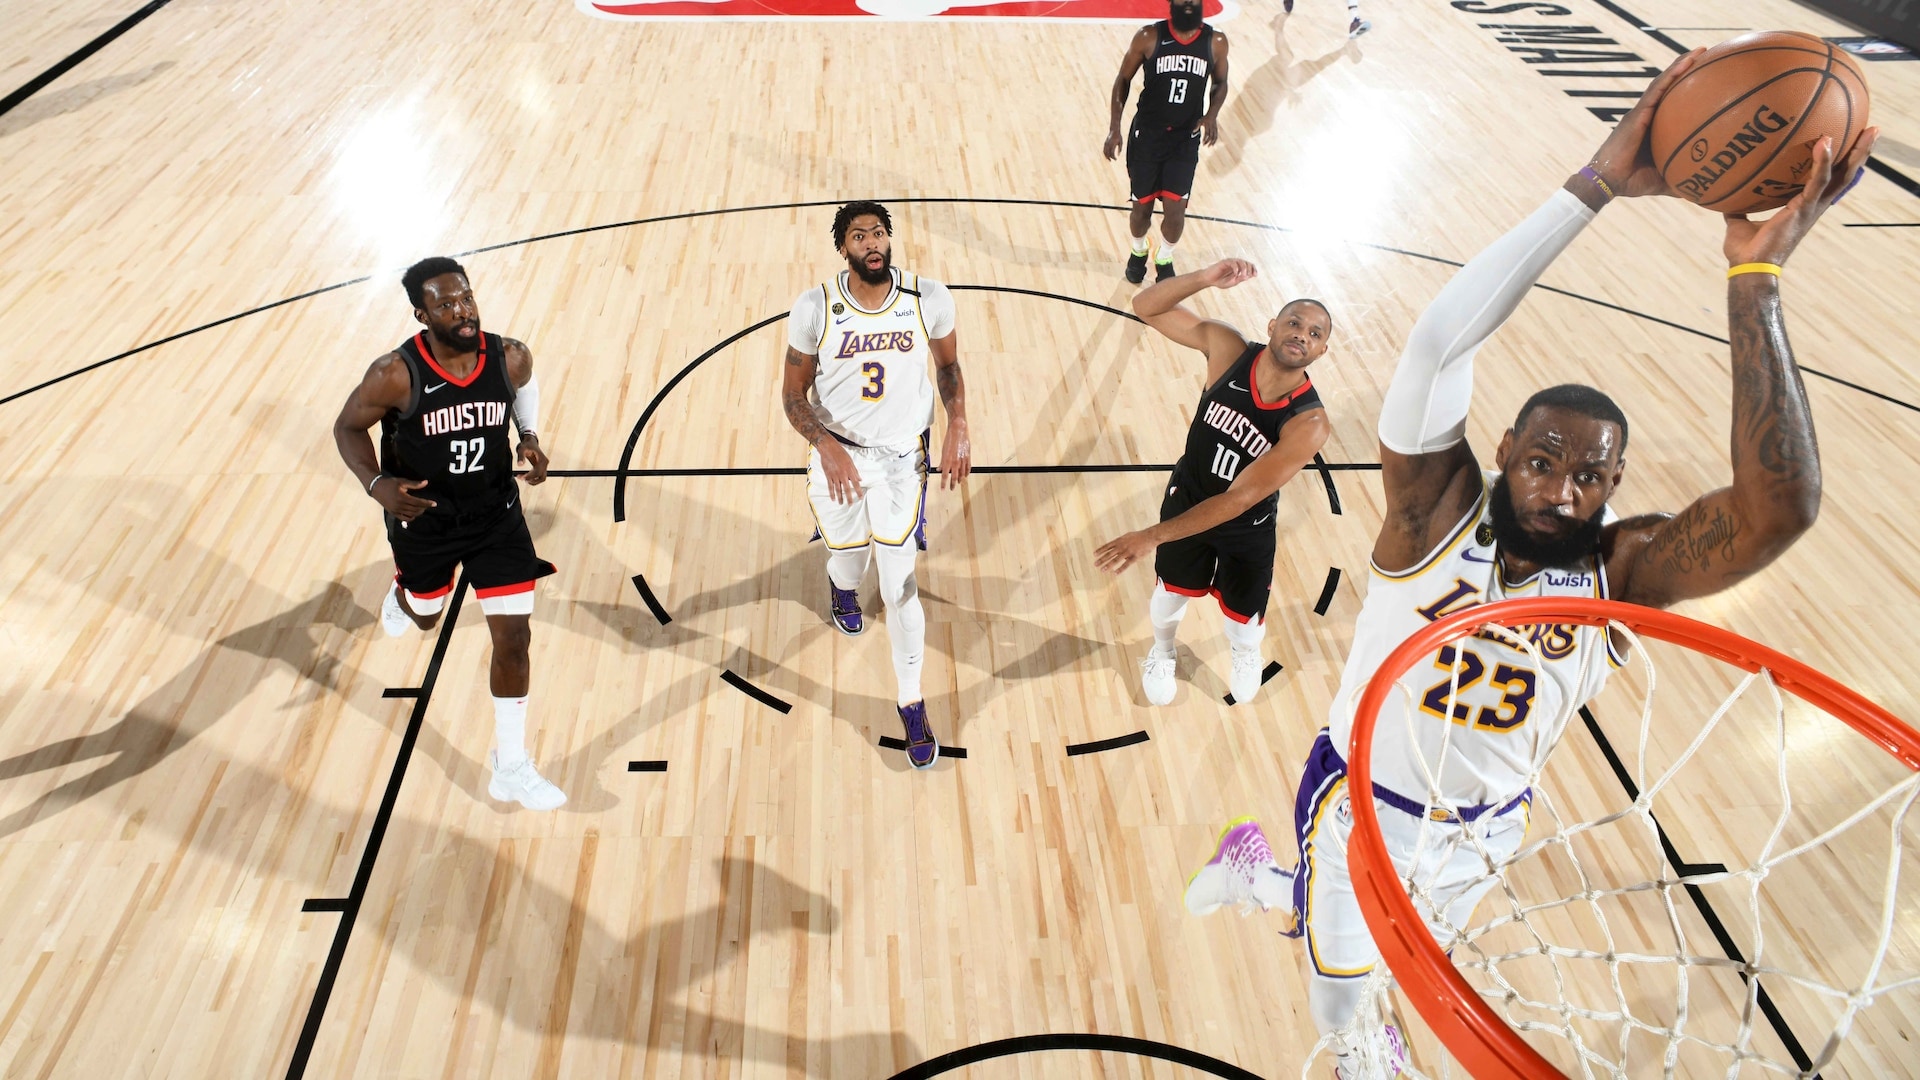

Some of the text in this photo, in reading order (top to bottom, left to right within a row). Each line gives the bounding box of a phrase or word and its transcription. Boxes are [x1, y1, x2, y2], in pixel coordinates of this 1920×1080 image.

[1156, 55, 1208, 78] HOUSTON
[1477, 23, 1662, 130] MATT
[1168, 78, 1188, 104] 13
[893, 309, 915, 318] wish
[834, 330, 915, 360] LAKERS
[861, 360, 885, 403] 3
[422, 401, 507, 437] HOUSTON
[448, 436, 486, 475] 32
[1211, 442, 1241, 482] 10
[1545, 572, 1592, 588] wish
[1415, 577, 1579, 662] LRS
[1419, 645, 1537, 734] 23
